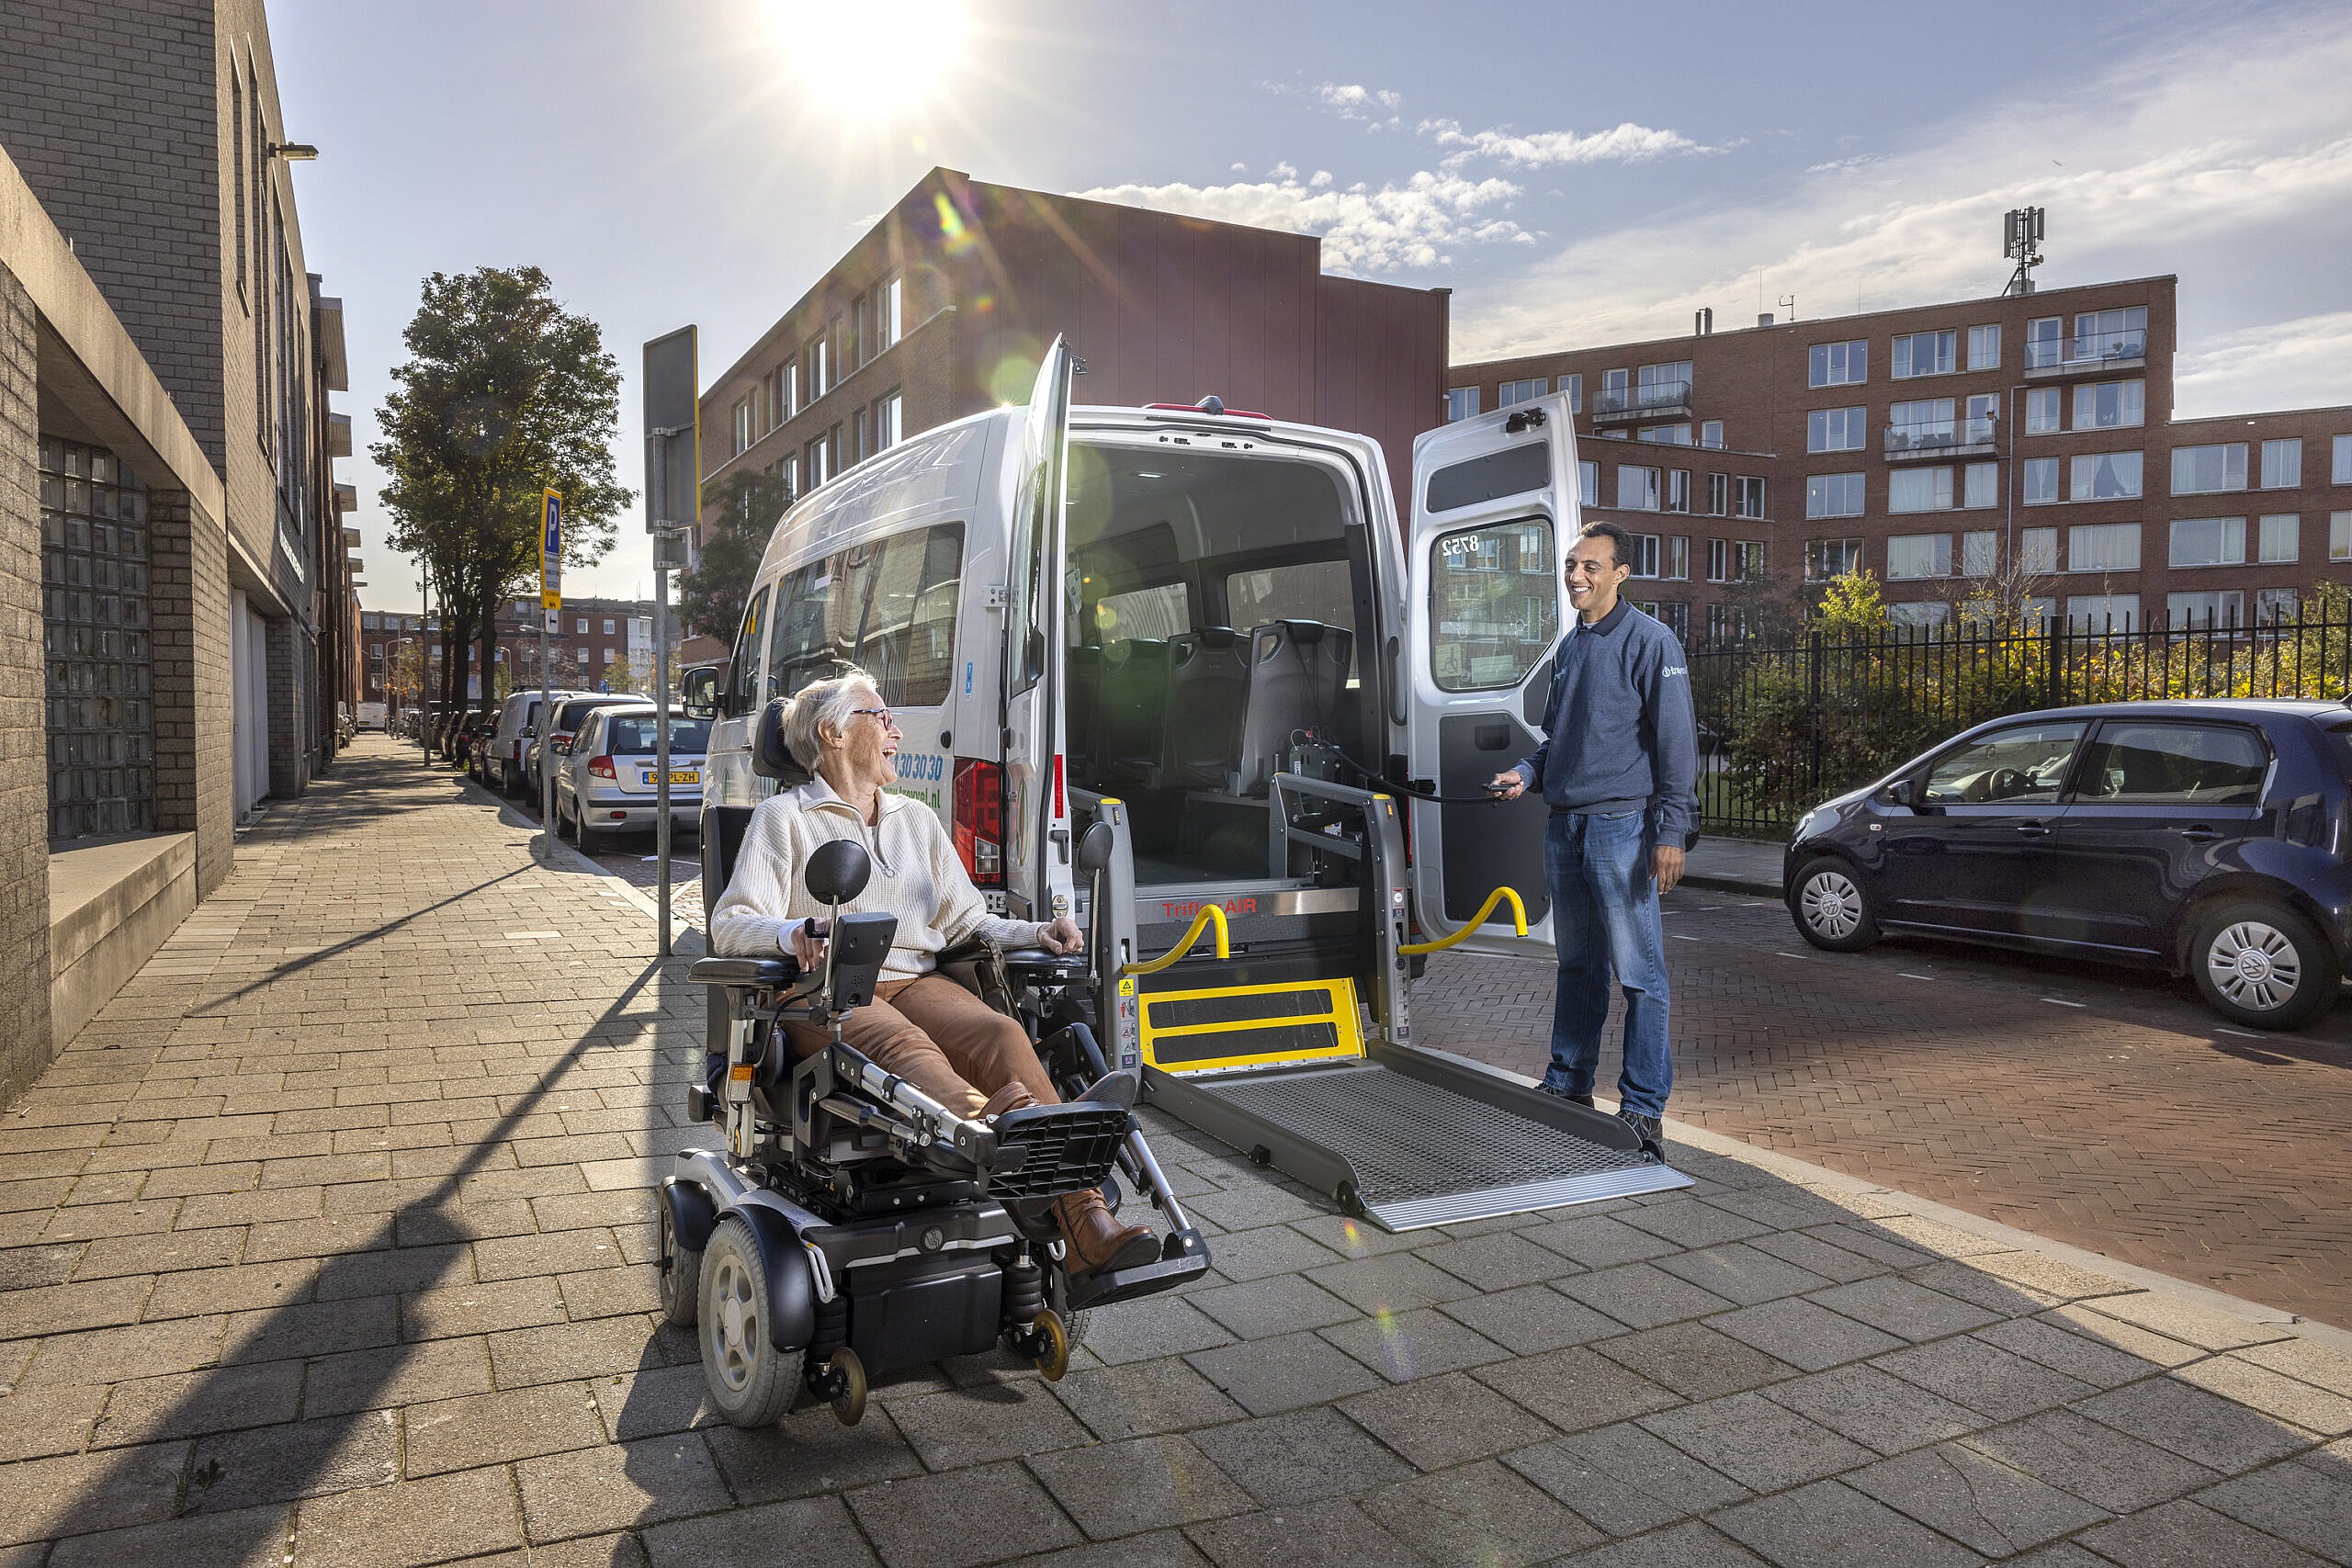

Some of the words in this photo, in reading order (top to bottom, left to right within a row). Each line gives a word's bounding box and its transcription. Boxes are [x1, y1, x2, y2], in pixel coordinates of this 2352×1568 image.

[548, 502, 557, 547] P
[1161, 901, 1222, 918] Trifl
[1225, 897, 1257, 915] AIR
